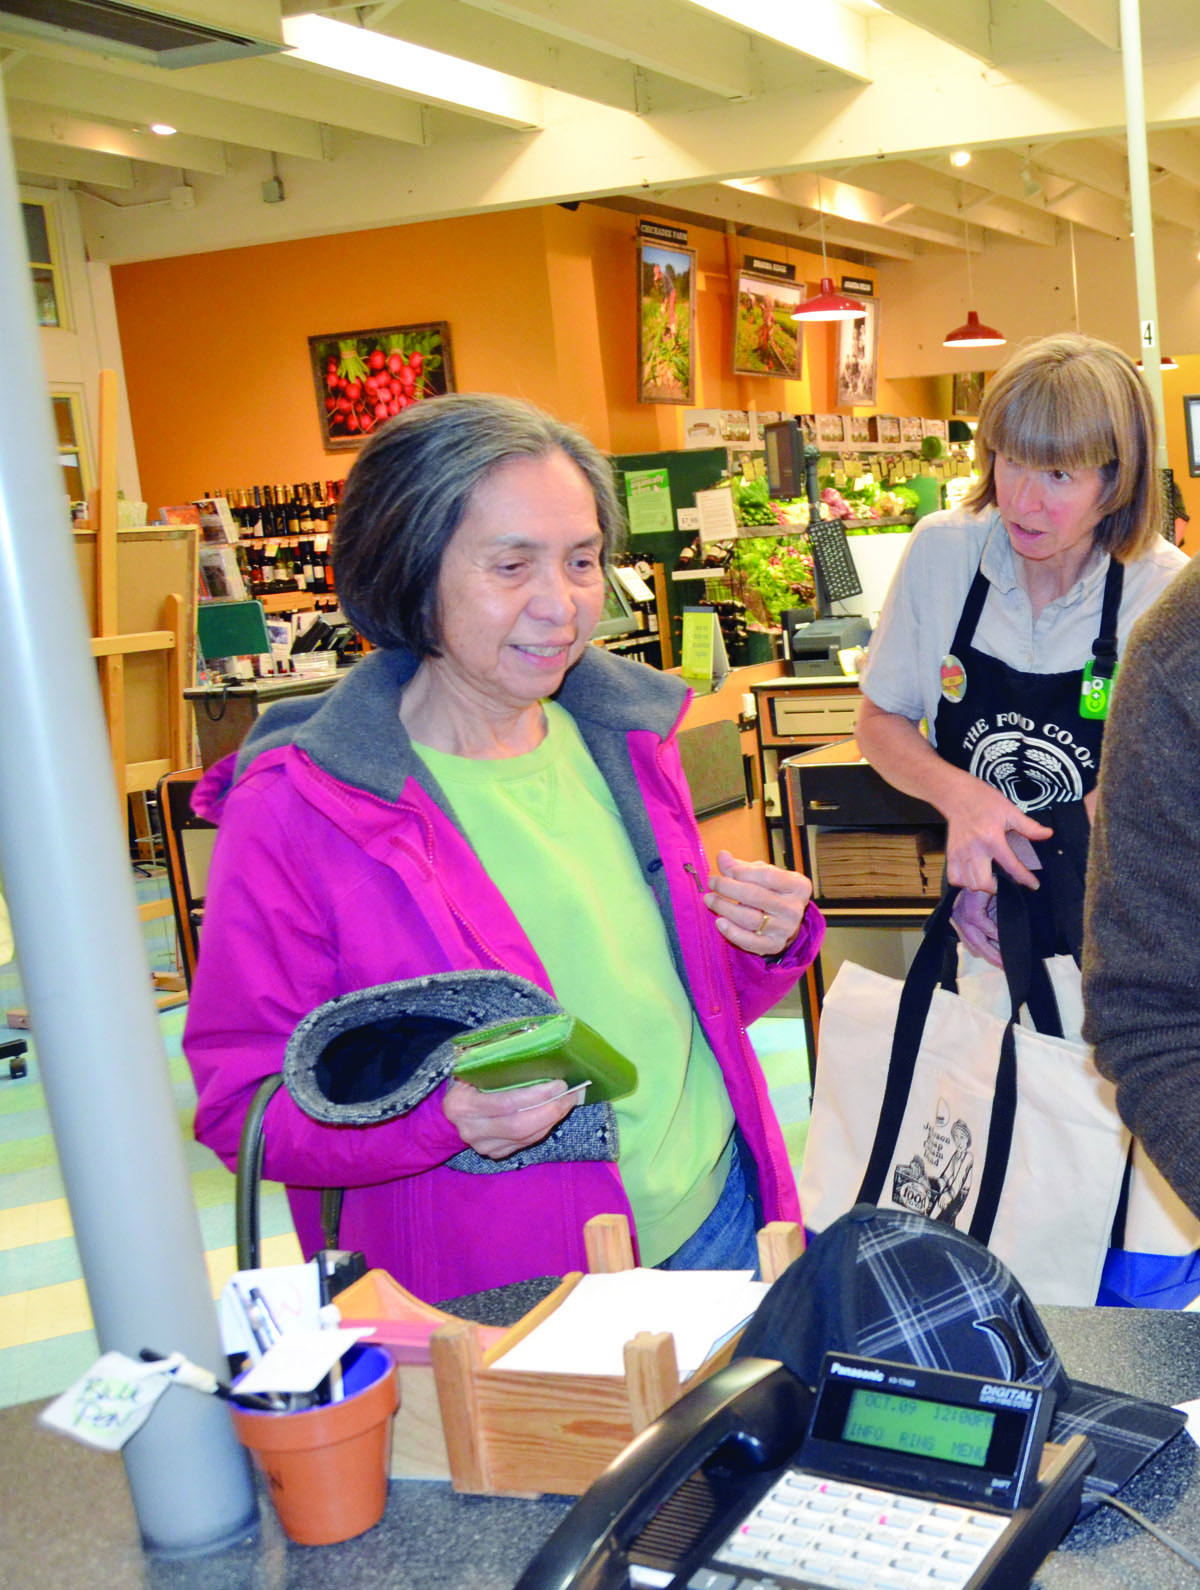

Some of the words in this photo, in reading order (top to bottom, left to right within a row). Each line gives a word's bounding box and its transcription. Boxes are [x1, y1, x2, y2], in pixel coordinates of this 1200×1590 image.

[1143, 322, 1153, 345] 4
[962, 718, 990, 752] THE
[831, 1361, 886, 1383] Panasonic
[981, 1384, 1034, 1402] DIGITAL
[849, 1421, 885, 1442] INFO
[899, 1431, 936, 1452] RING
[951, 1441, 987, 1461] MENU
